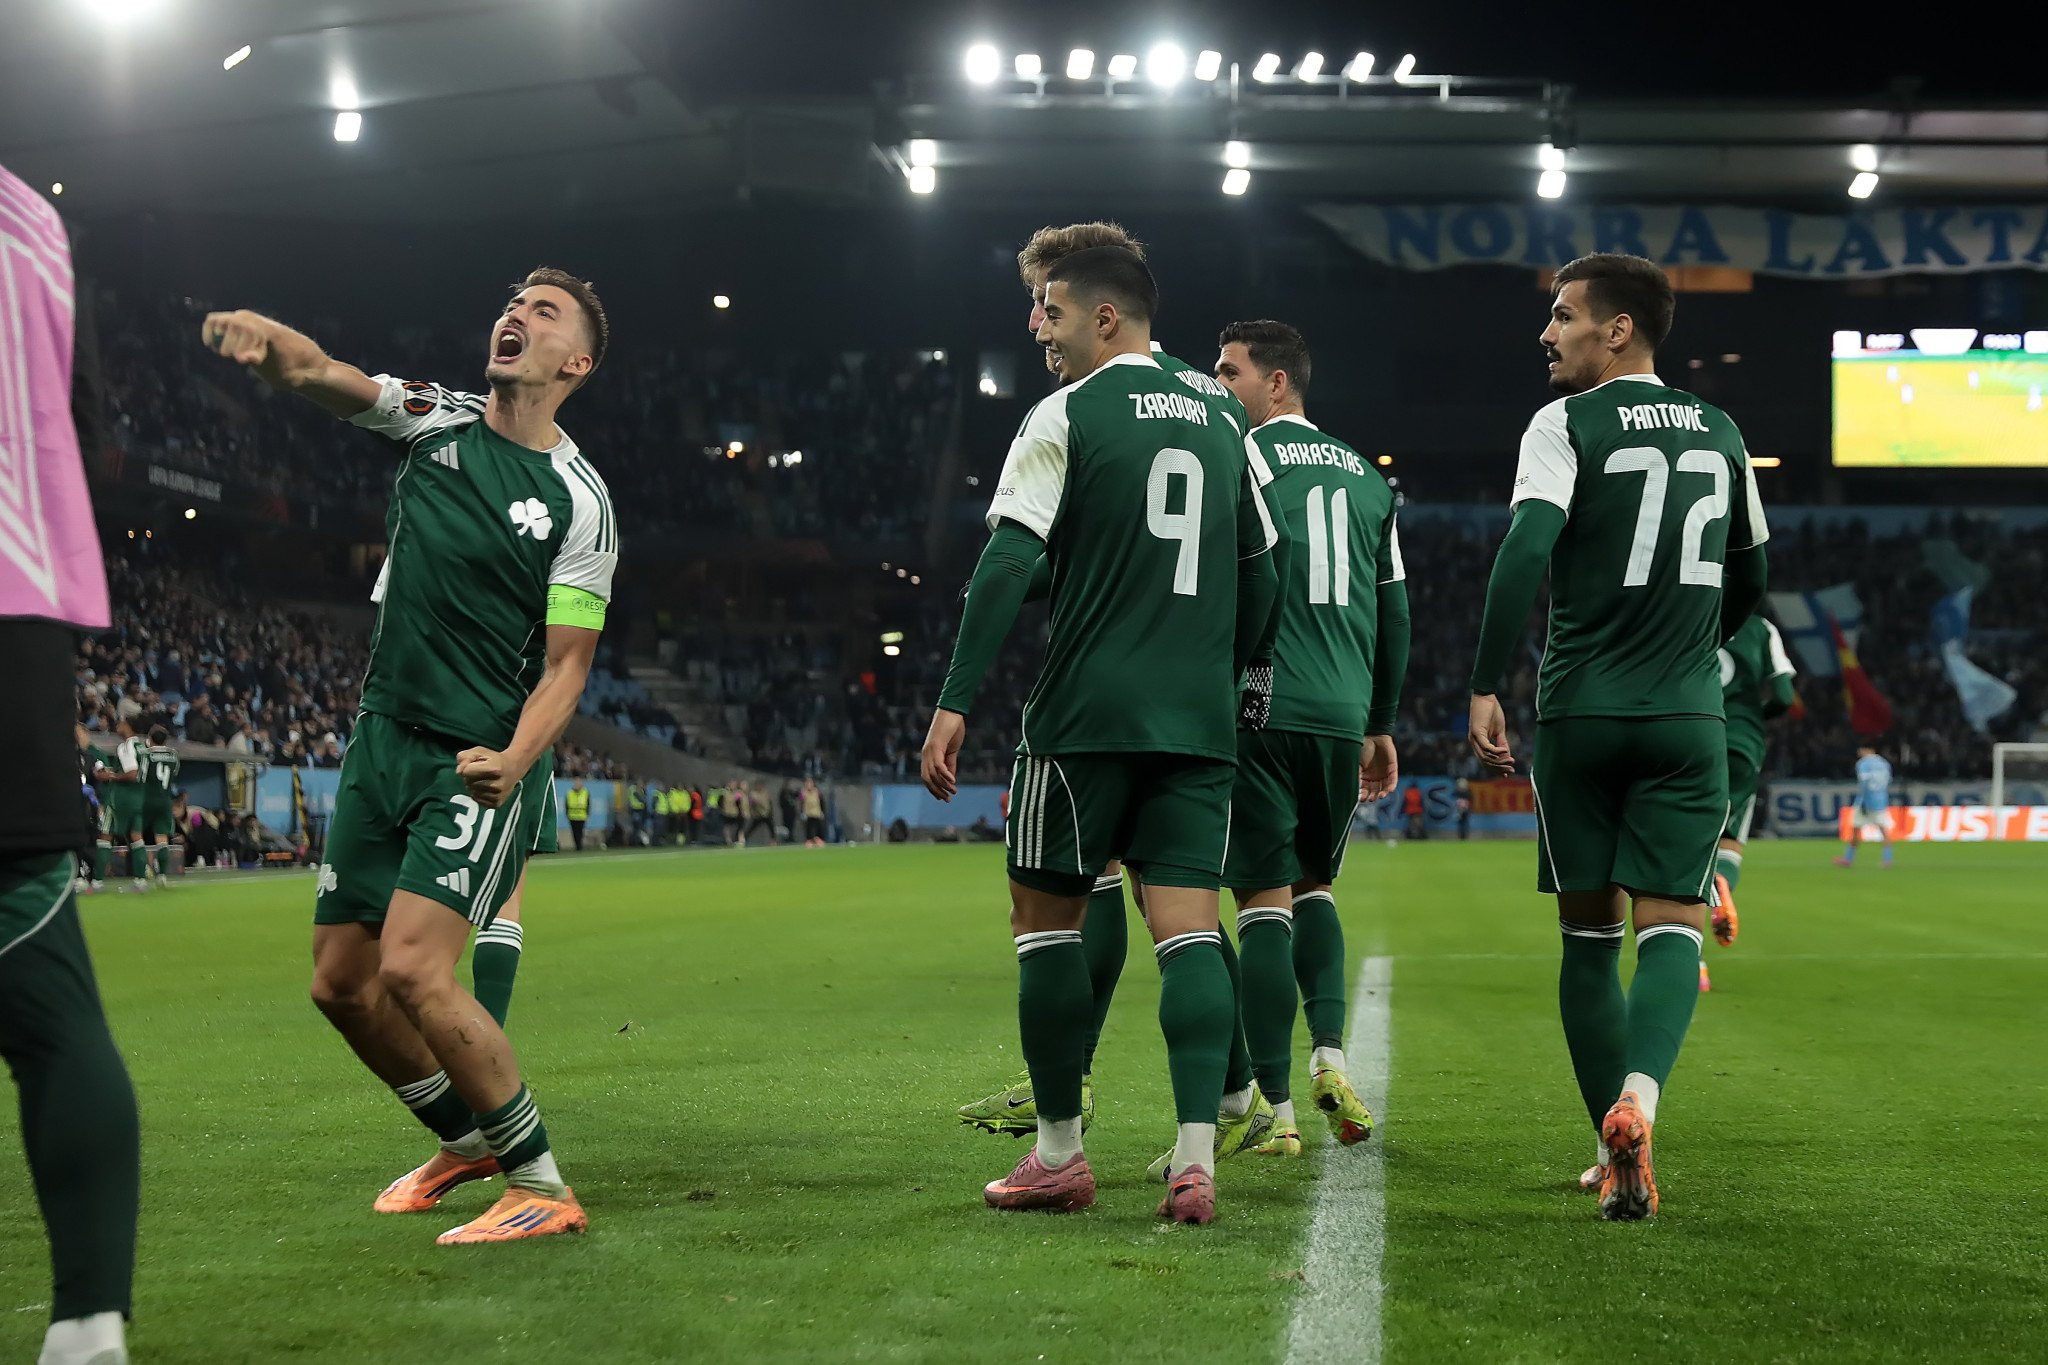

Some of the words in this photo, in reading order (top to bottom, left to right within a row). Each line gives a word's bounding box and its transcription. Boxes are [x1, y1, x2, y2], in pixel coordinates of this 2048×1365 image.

[1385, 204, 1729, 264] NORRA
[1128, 392, 1208, 426] ZAROURY
[1617, 403, 1710, 433] PANTOVIĆ
[1273, 442, 1365, 476] BAKASETAS
[1147, 448, 1205, 596] 9
[1603, 446, 1730, 588] 72
[1306, 485, 1351, 607] 11
[156, 762, 171, 790] 4
[434, 794, 496, 863] 31
[1907, 806, 2018, 840] JUST
